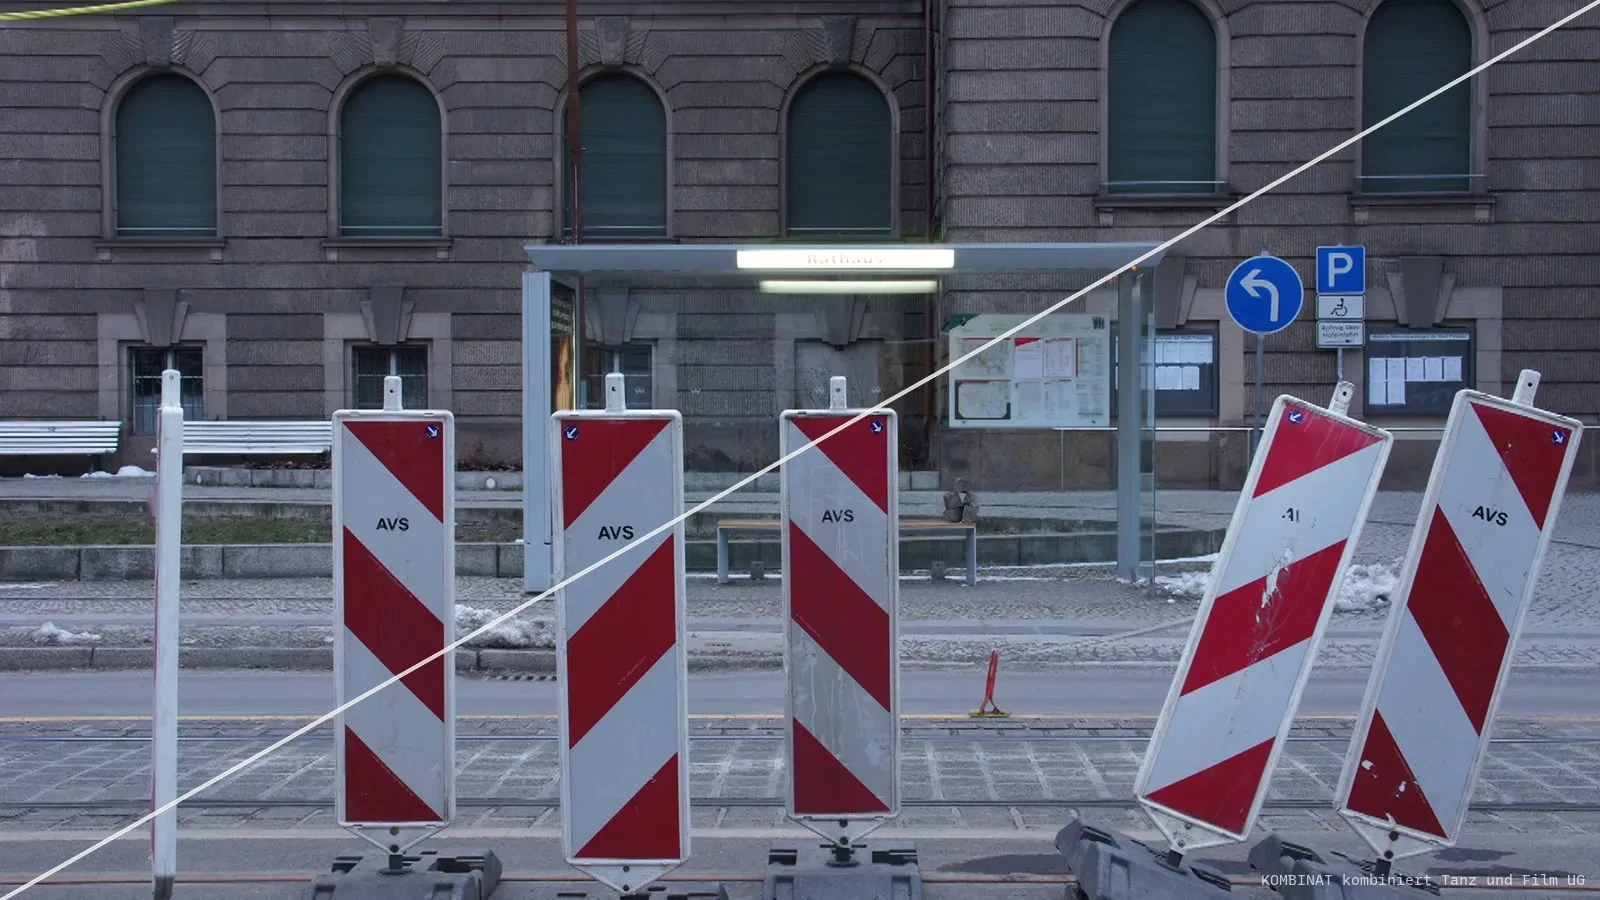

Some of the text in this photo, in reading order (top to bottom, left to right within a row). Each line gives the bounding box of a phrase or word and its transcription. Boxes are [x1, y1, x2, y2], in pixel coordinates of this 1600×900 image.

[807, 252, 884, 264] Rathaus
[1328, 252, 1353, 287] P
[822, 509, 855, 523] AVS
[1472, 505, 1508, 527] AVS
[376, 517, 409, 532] AVS
[598, 525, 634, 540] AVS
